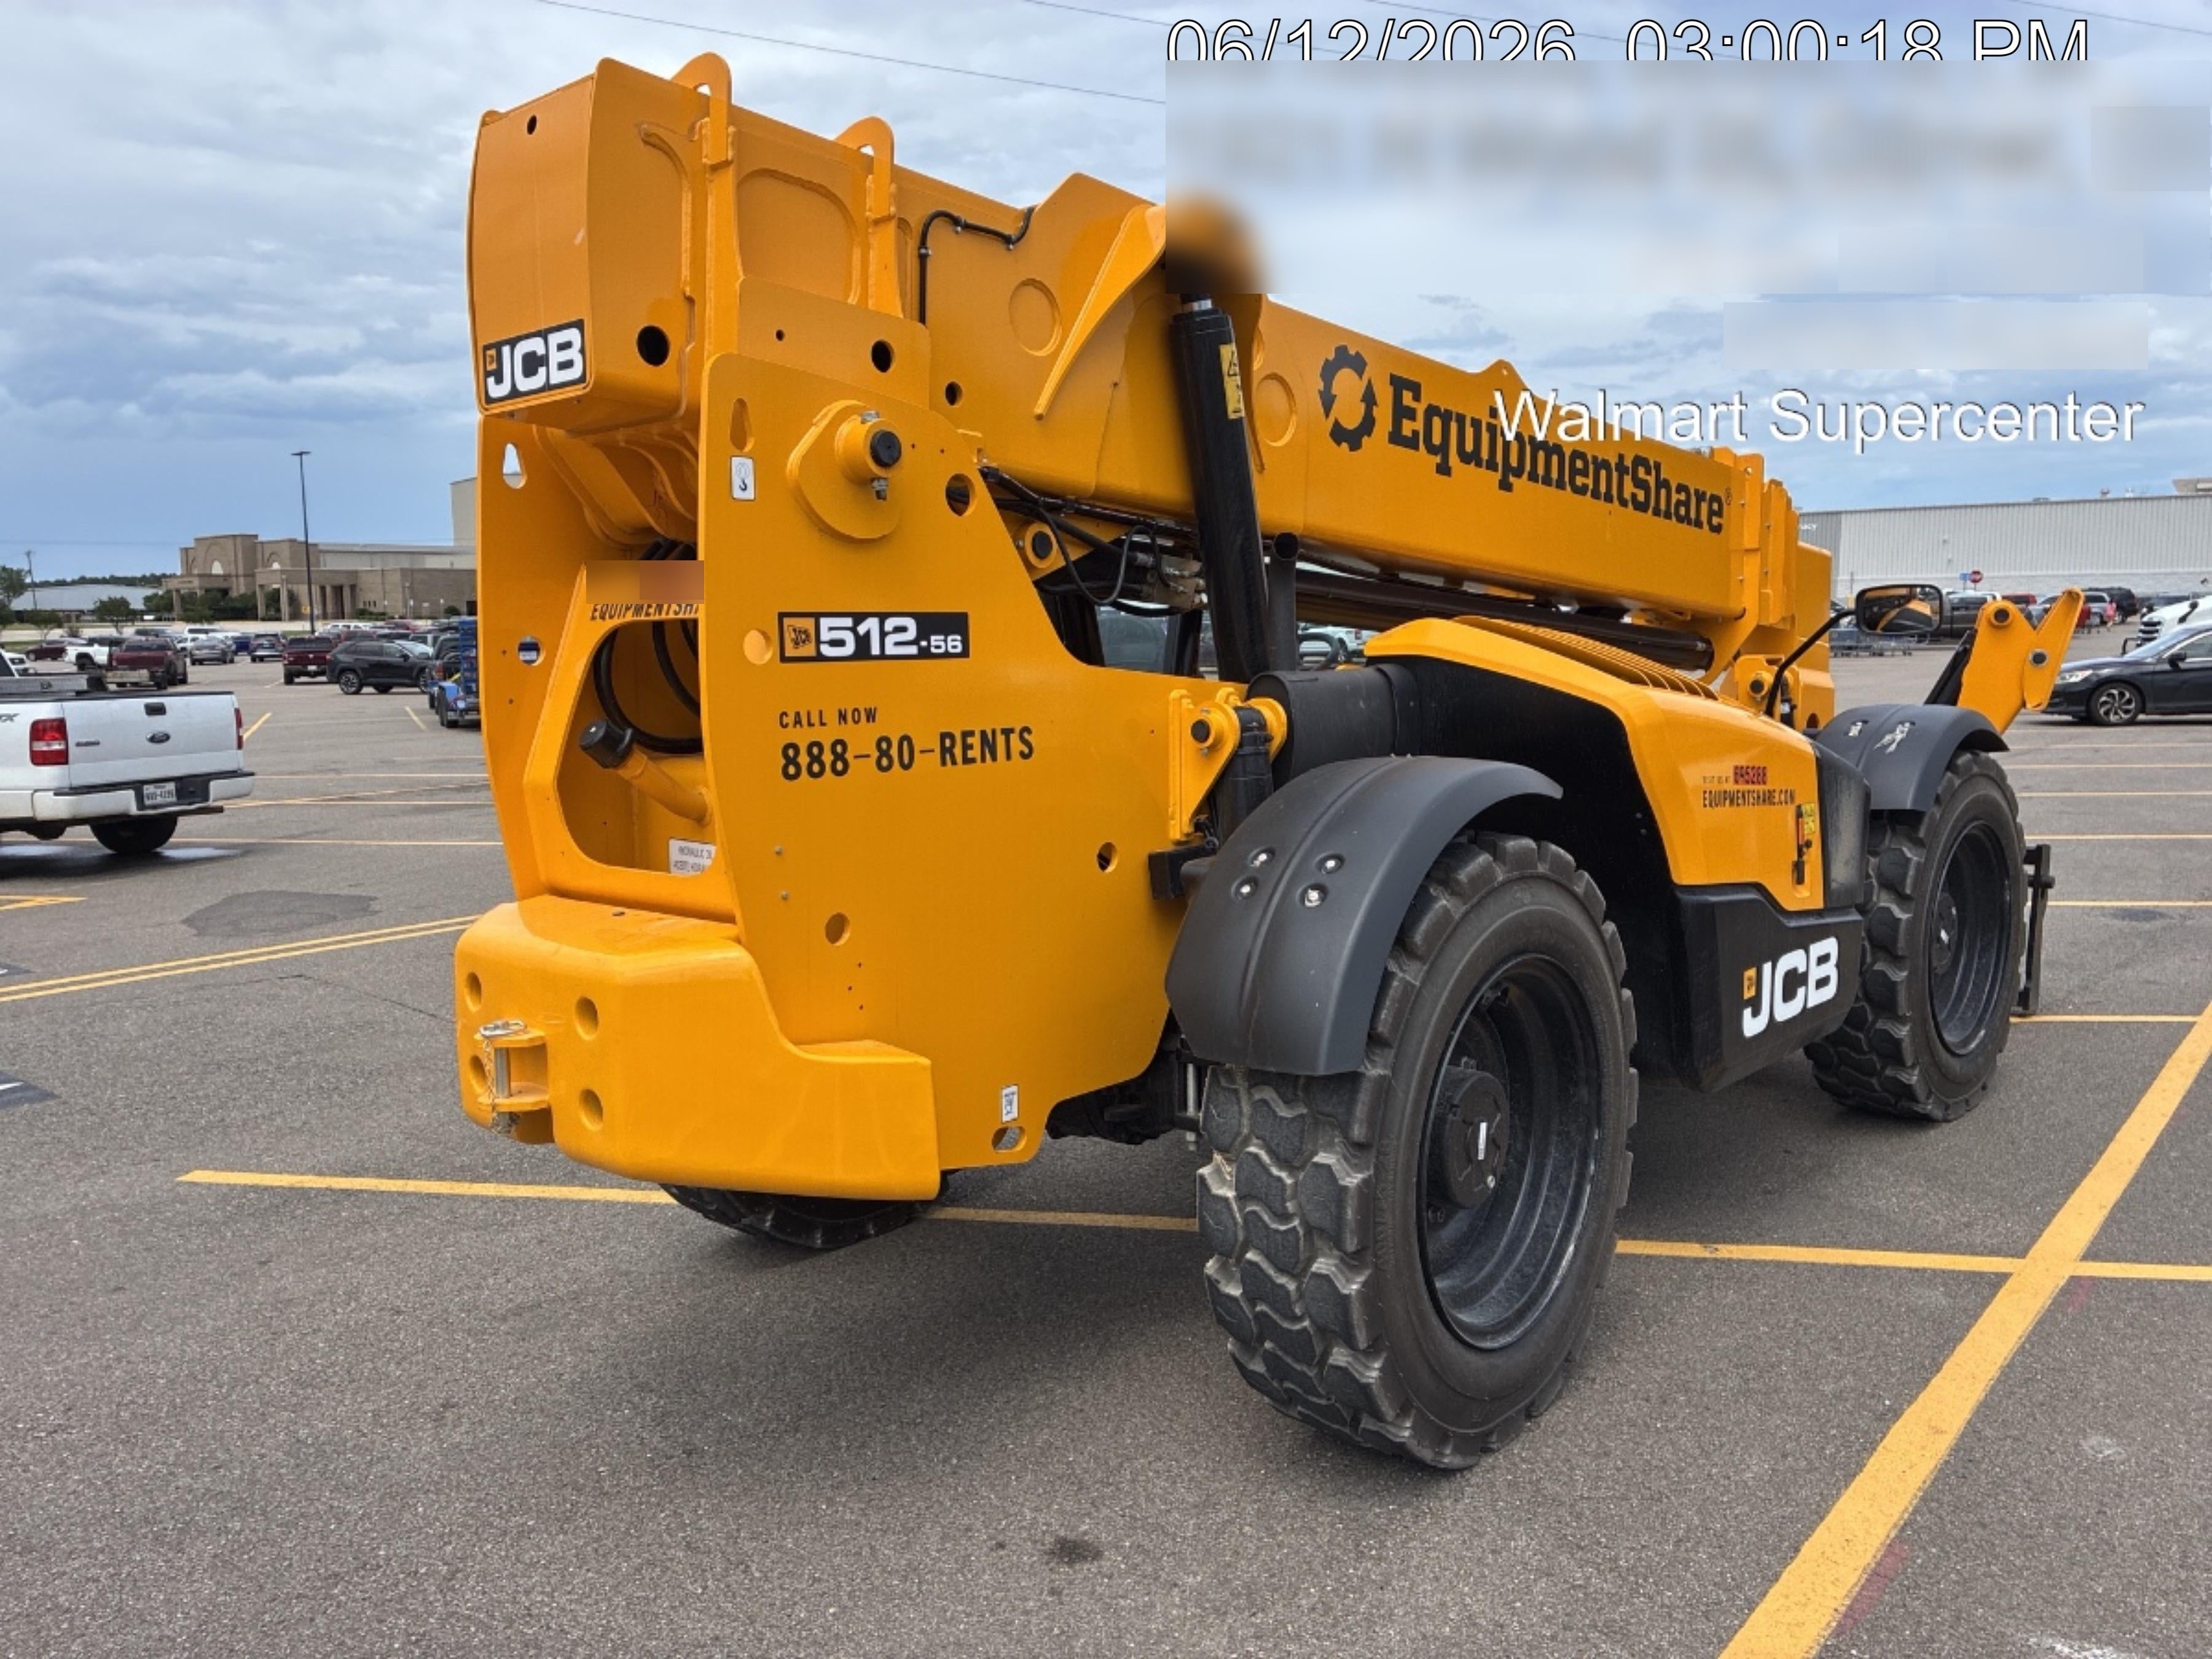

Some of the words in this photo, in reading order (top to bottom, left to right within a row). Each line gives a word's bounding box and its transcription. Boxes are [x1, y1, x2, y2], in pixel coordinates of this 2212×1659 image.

[487, 327, 583, 398] JCB
[779, 710, 828, 728] CALL
[838, 707, 878, 724] NOW
[781, 726, 1035, 781] 888-80-RENTS
[1703, 789, 1795, 809] EQUIPMENTSHARE.COM
[1743, 936, 1838, 1037] JCB
